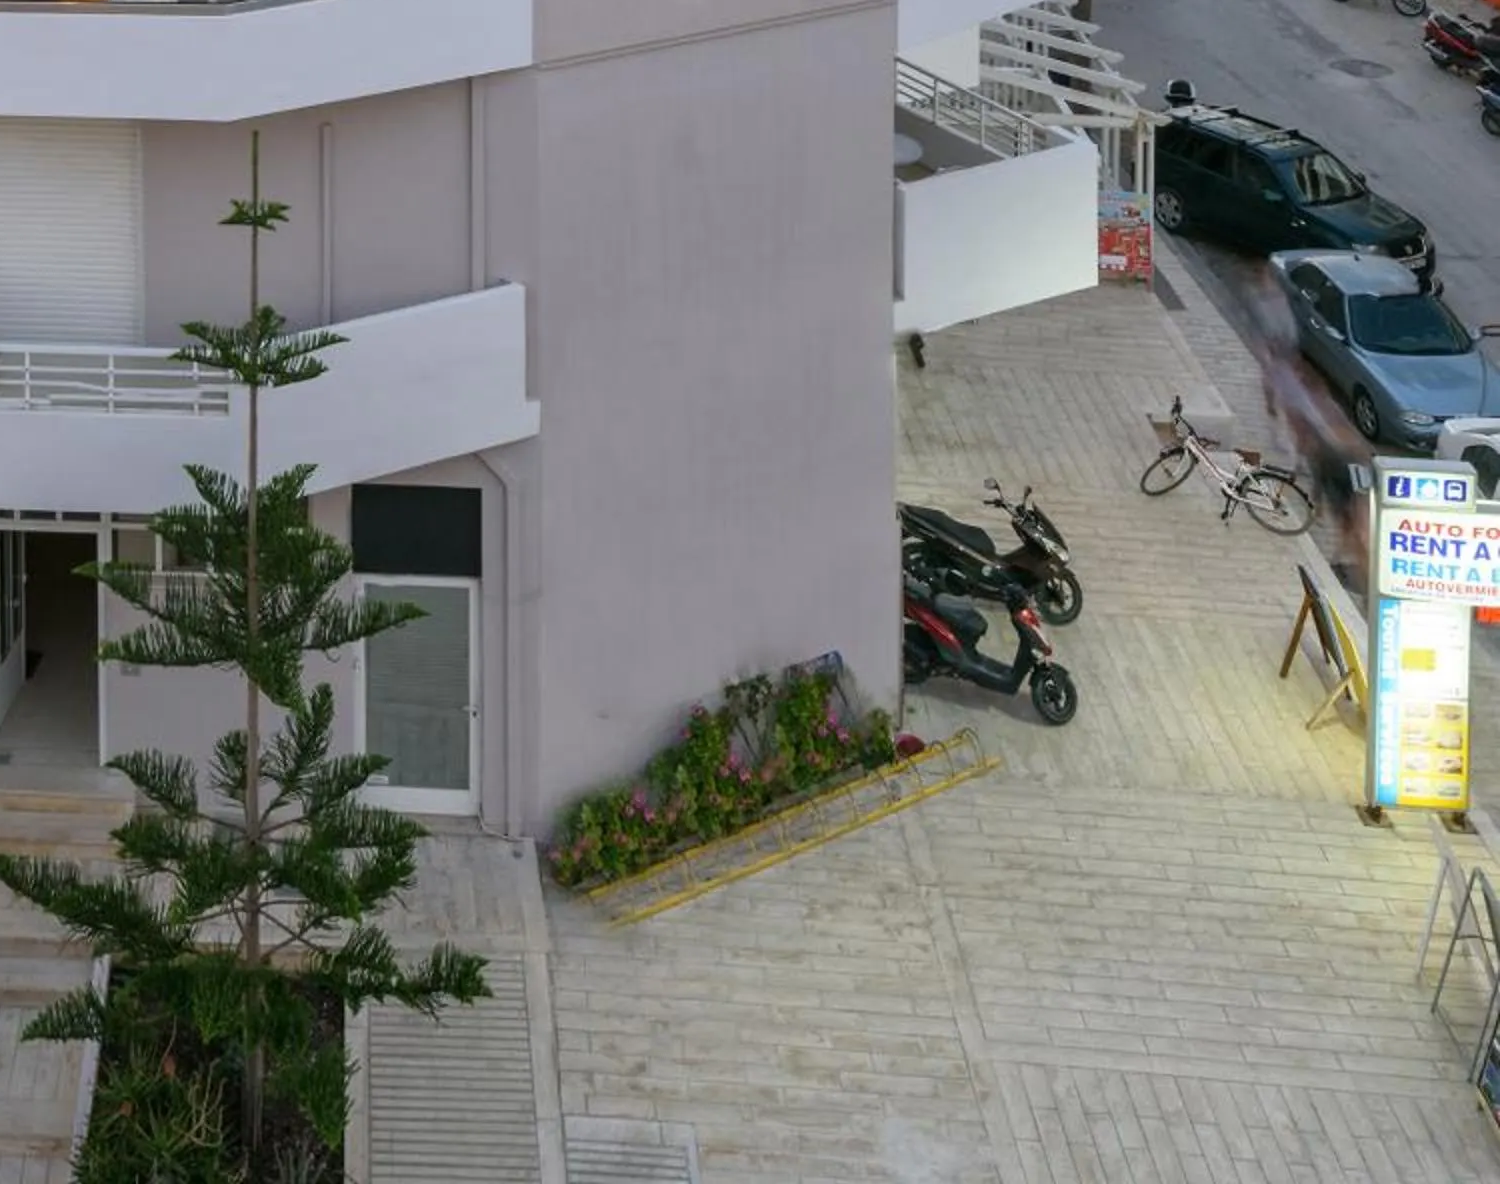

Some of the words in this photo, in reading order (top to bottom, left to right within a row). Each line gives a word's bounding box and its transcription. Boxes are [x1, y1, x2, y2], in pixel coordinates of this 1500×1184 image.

[1398, 518, 1464, 538] AUTO
[1389, 531, 1467, 559] RENT
[1473, 542, 1491, 561] A
[1391, 558, 1461, 581] RENT
[1466, 567, 1481, 583] A
